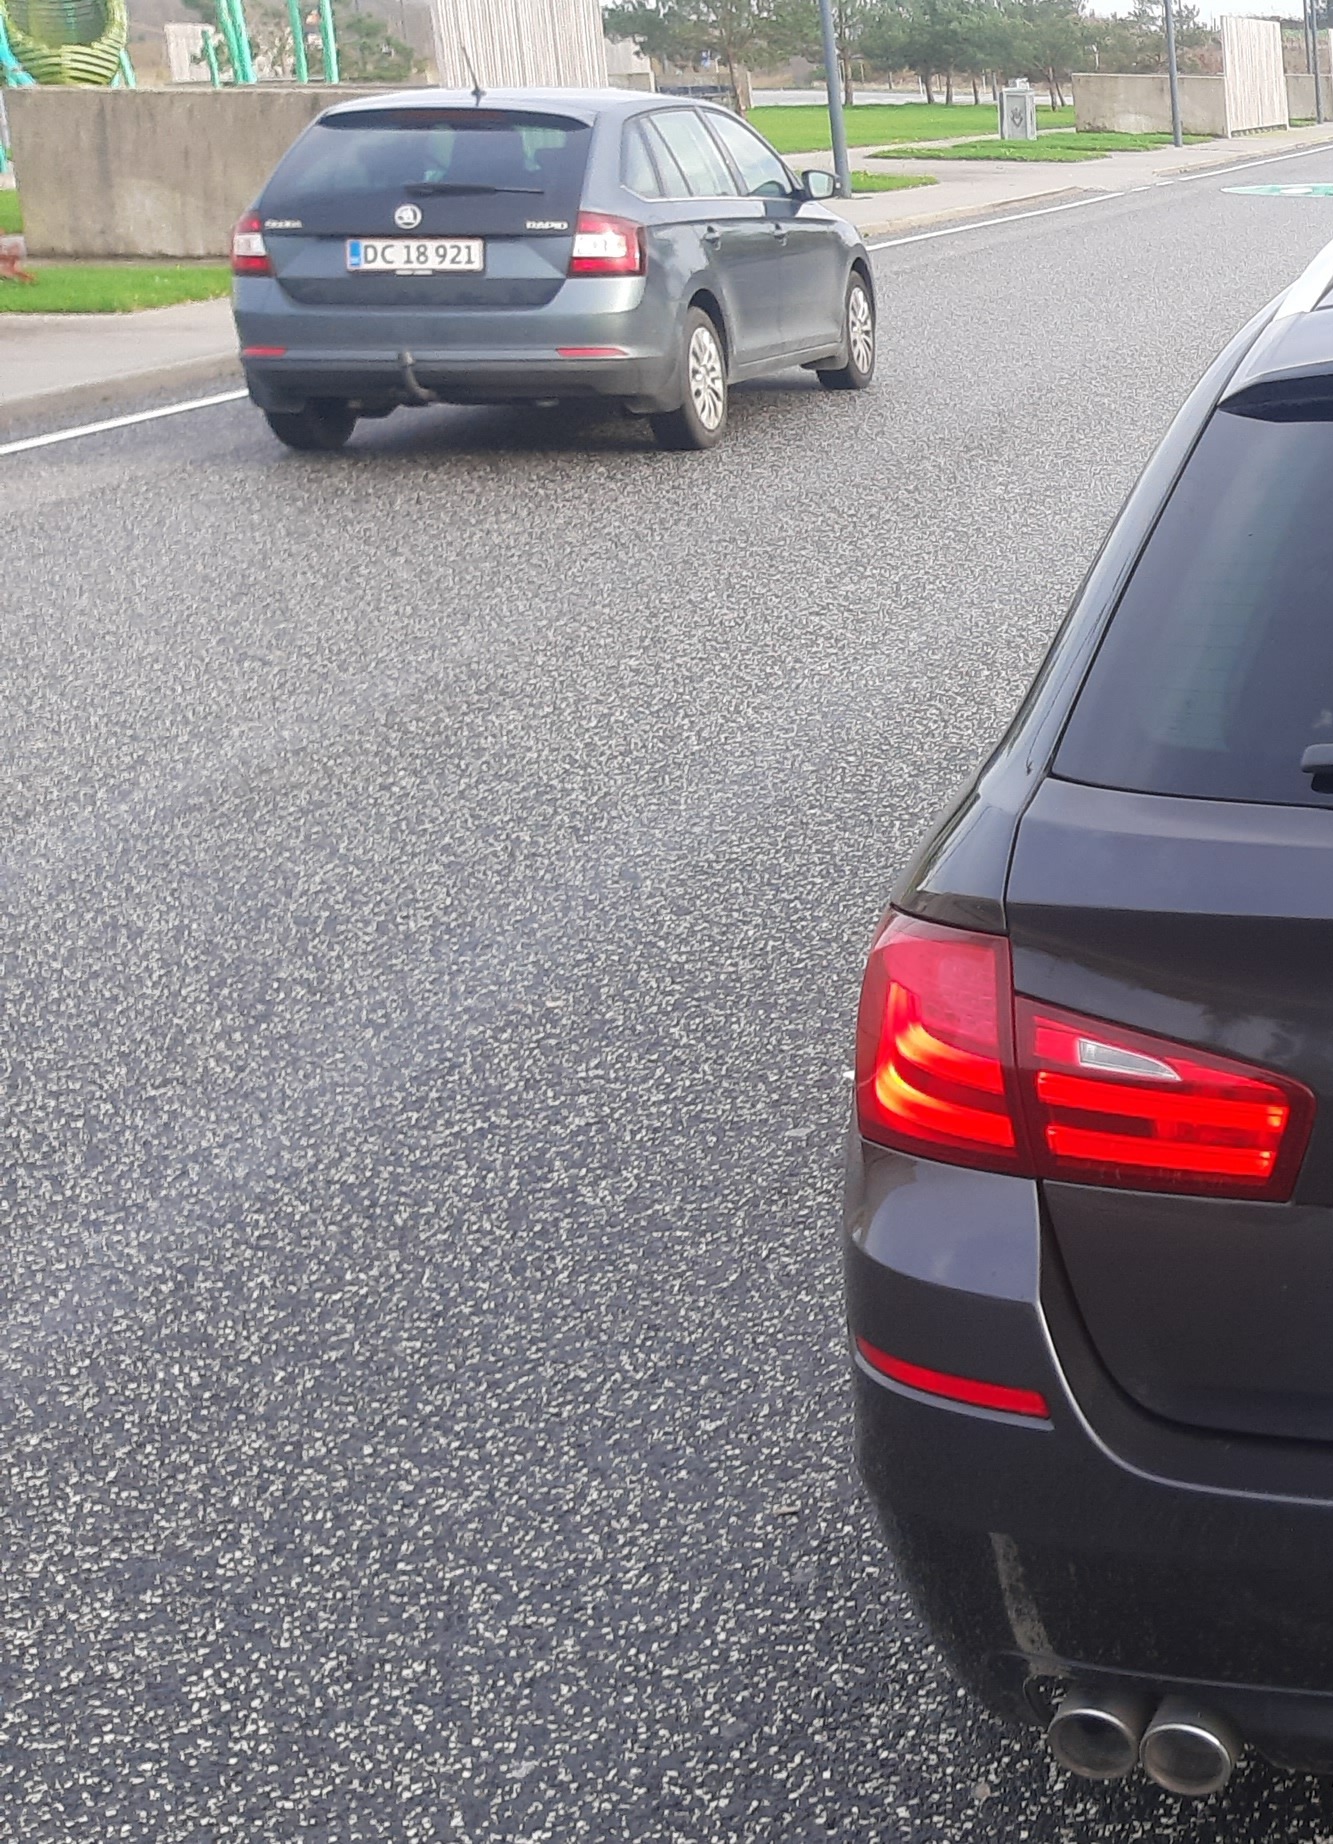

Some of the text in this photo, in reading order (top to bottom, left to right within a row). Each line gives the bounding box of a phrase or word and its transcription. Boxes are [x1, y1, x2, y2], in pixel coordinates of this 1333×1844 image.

[363, 244, 395, 265] DC
[403, 244, 429, 265] 18
[435, 244, 476, 265] 921
